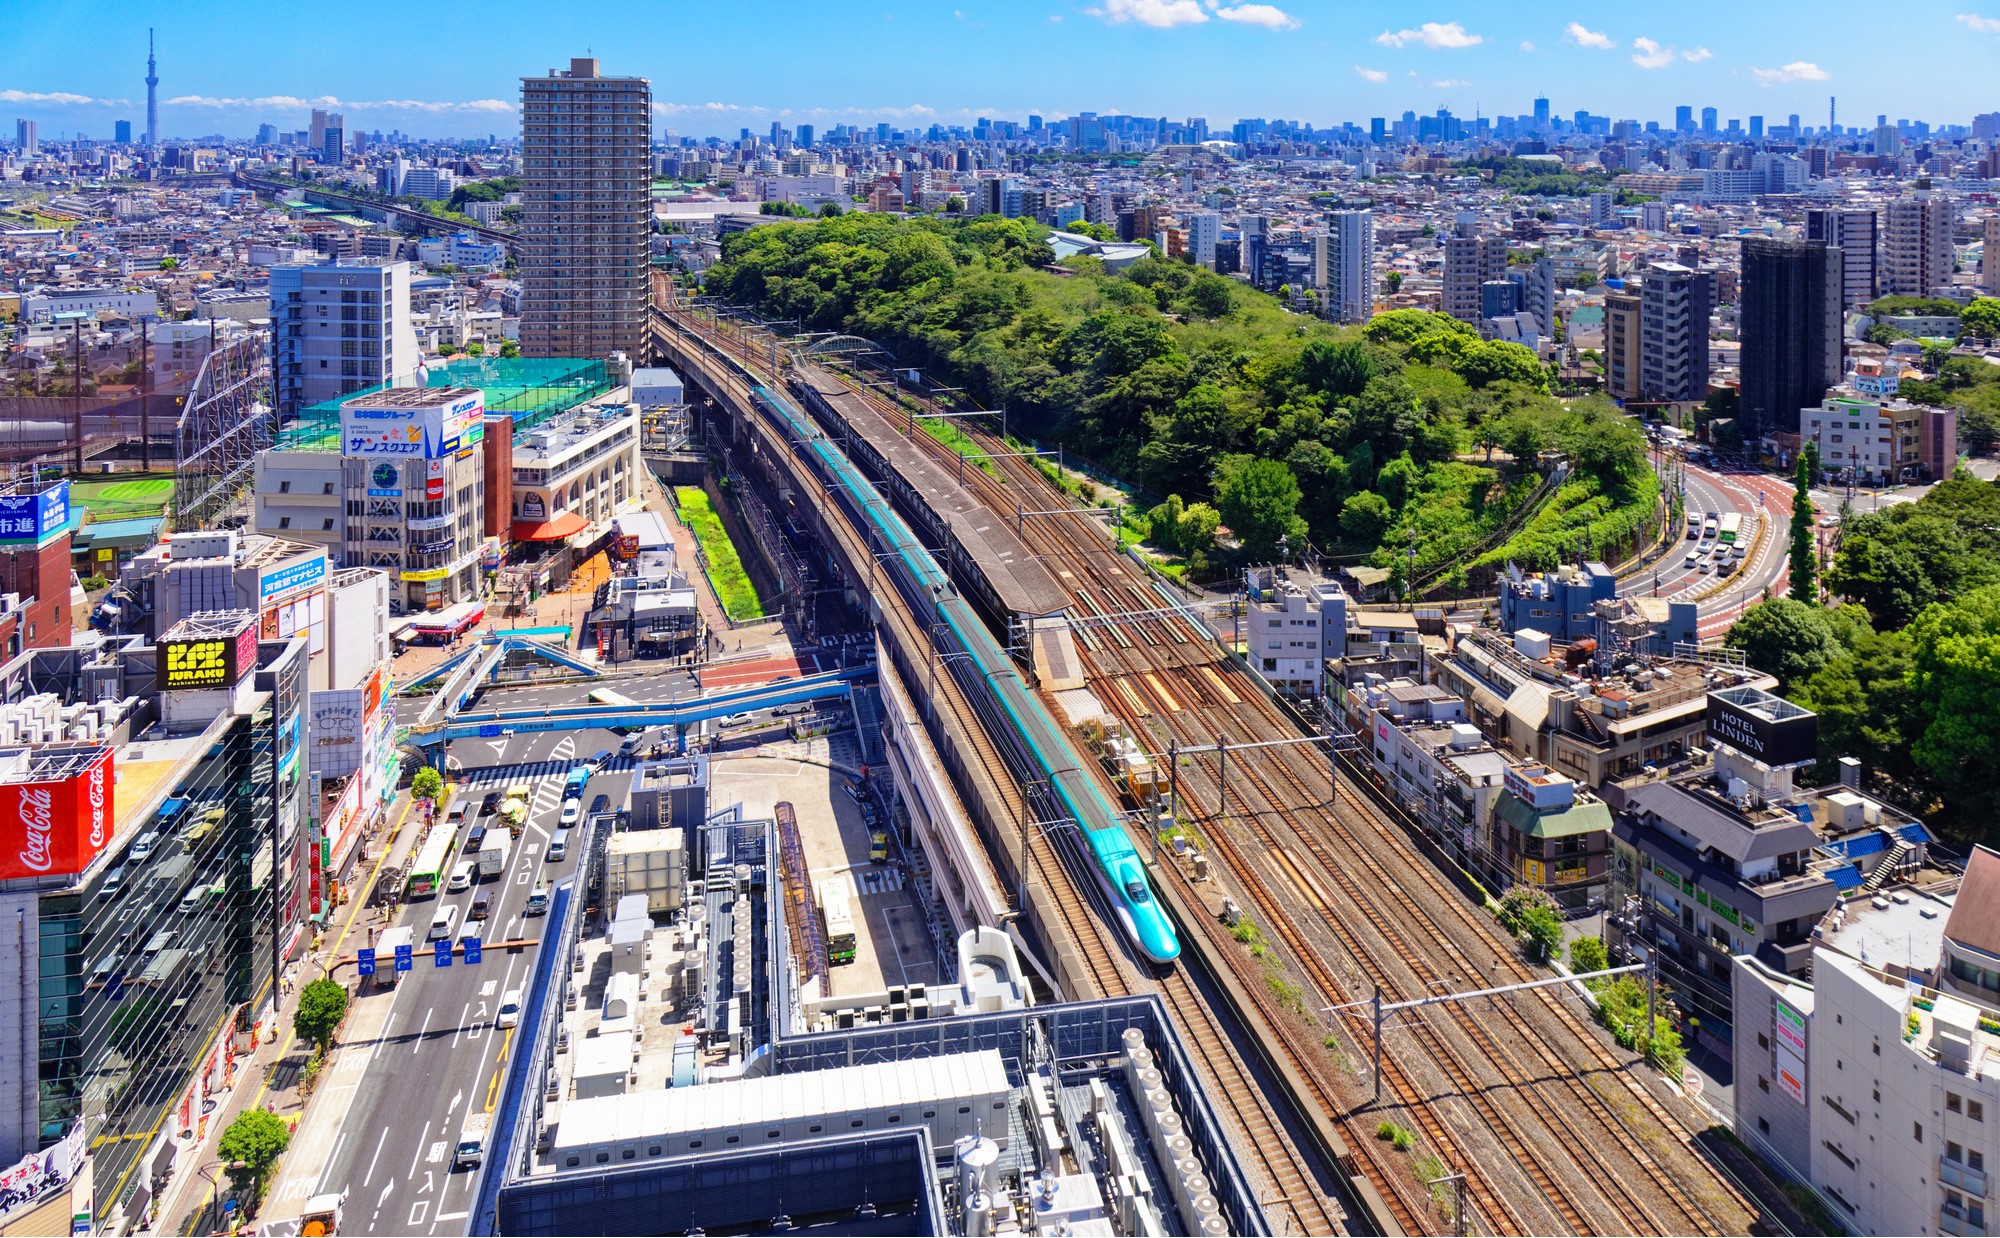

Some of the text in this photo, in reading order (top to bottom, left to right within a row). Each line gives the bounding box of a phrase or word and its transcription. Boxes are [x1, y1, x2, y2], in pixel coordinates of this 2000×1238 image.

[1858, 382, 1880, 392] アスカ
[350, 438, 423, 453] サンスクエア
[0, 517, 35, 534] 市進
[168, 668, 225, 681] JURAKU
[1721, 710, 1756, 735] HOTEL
[1713, 719, 1764, 753] LINDEN
[89, 765, 104, 847] Coca-Cola
[19, 786, 52, 871] Coca-Cola
